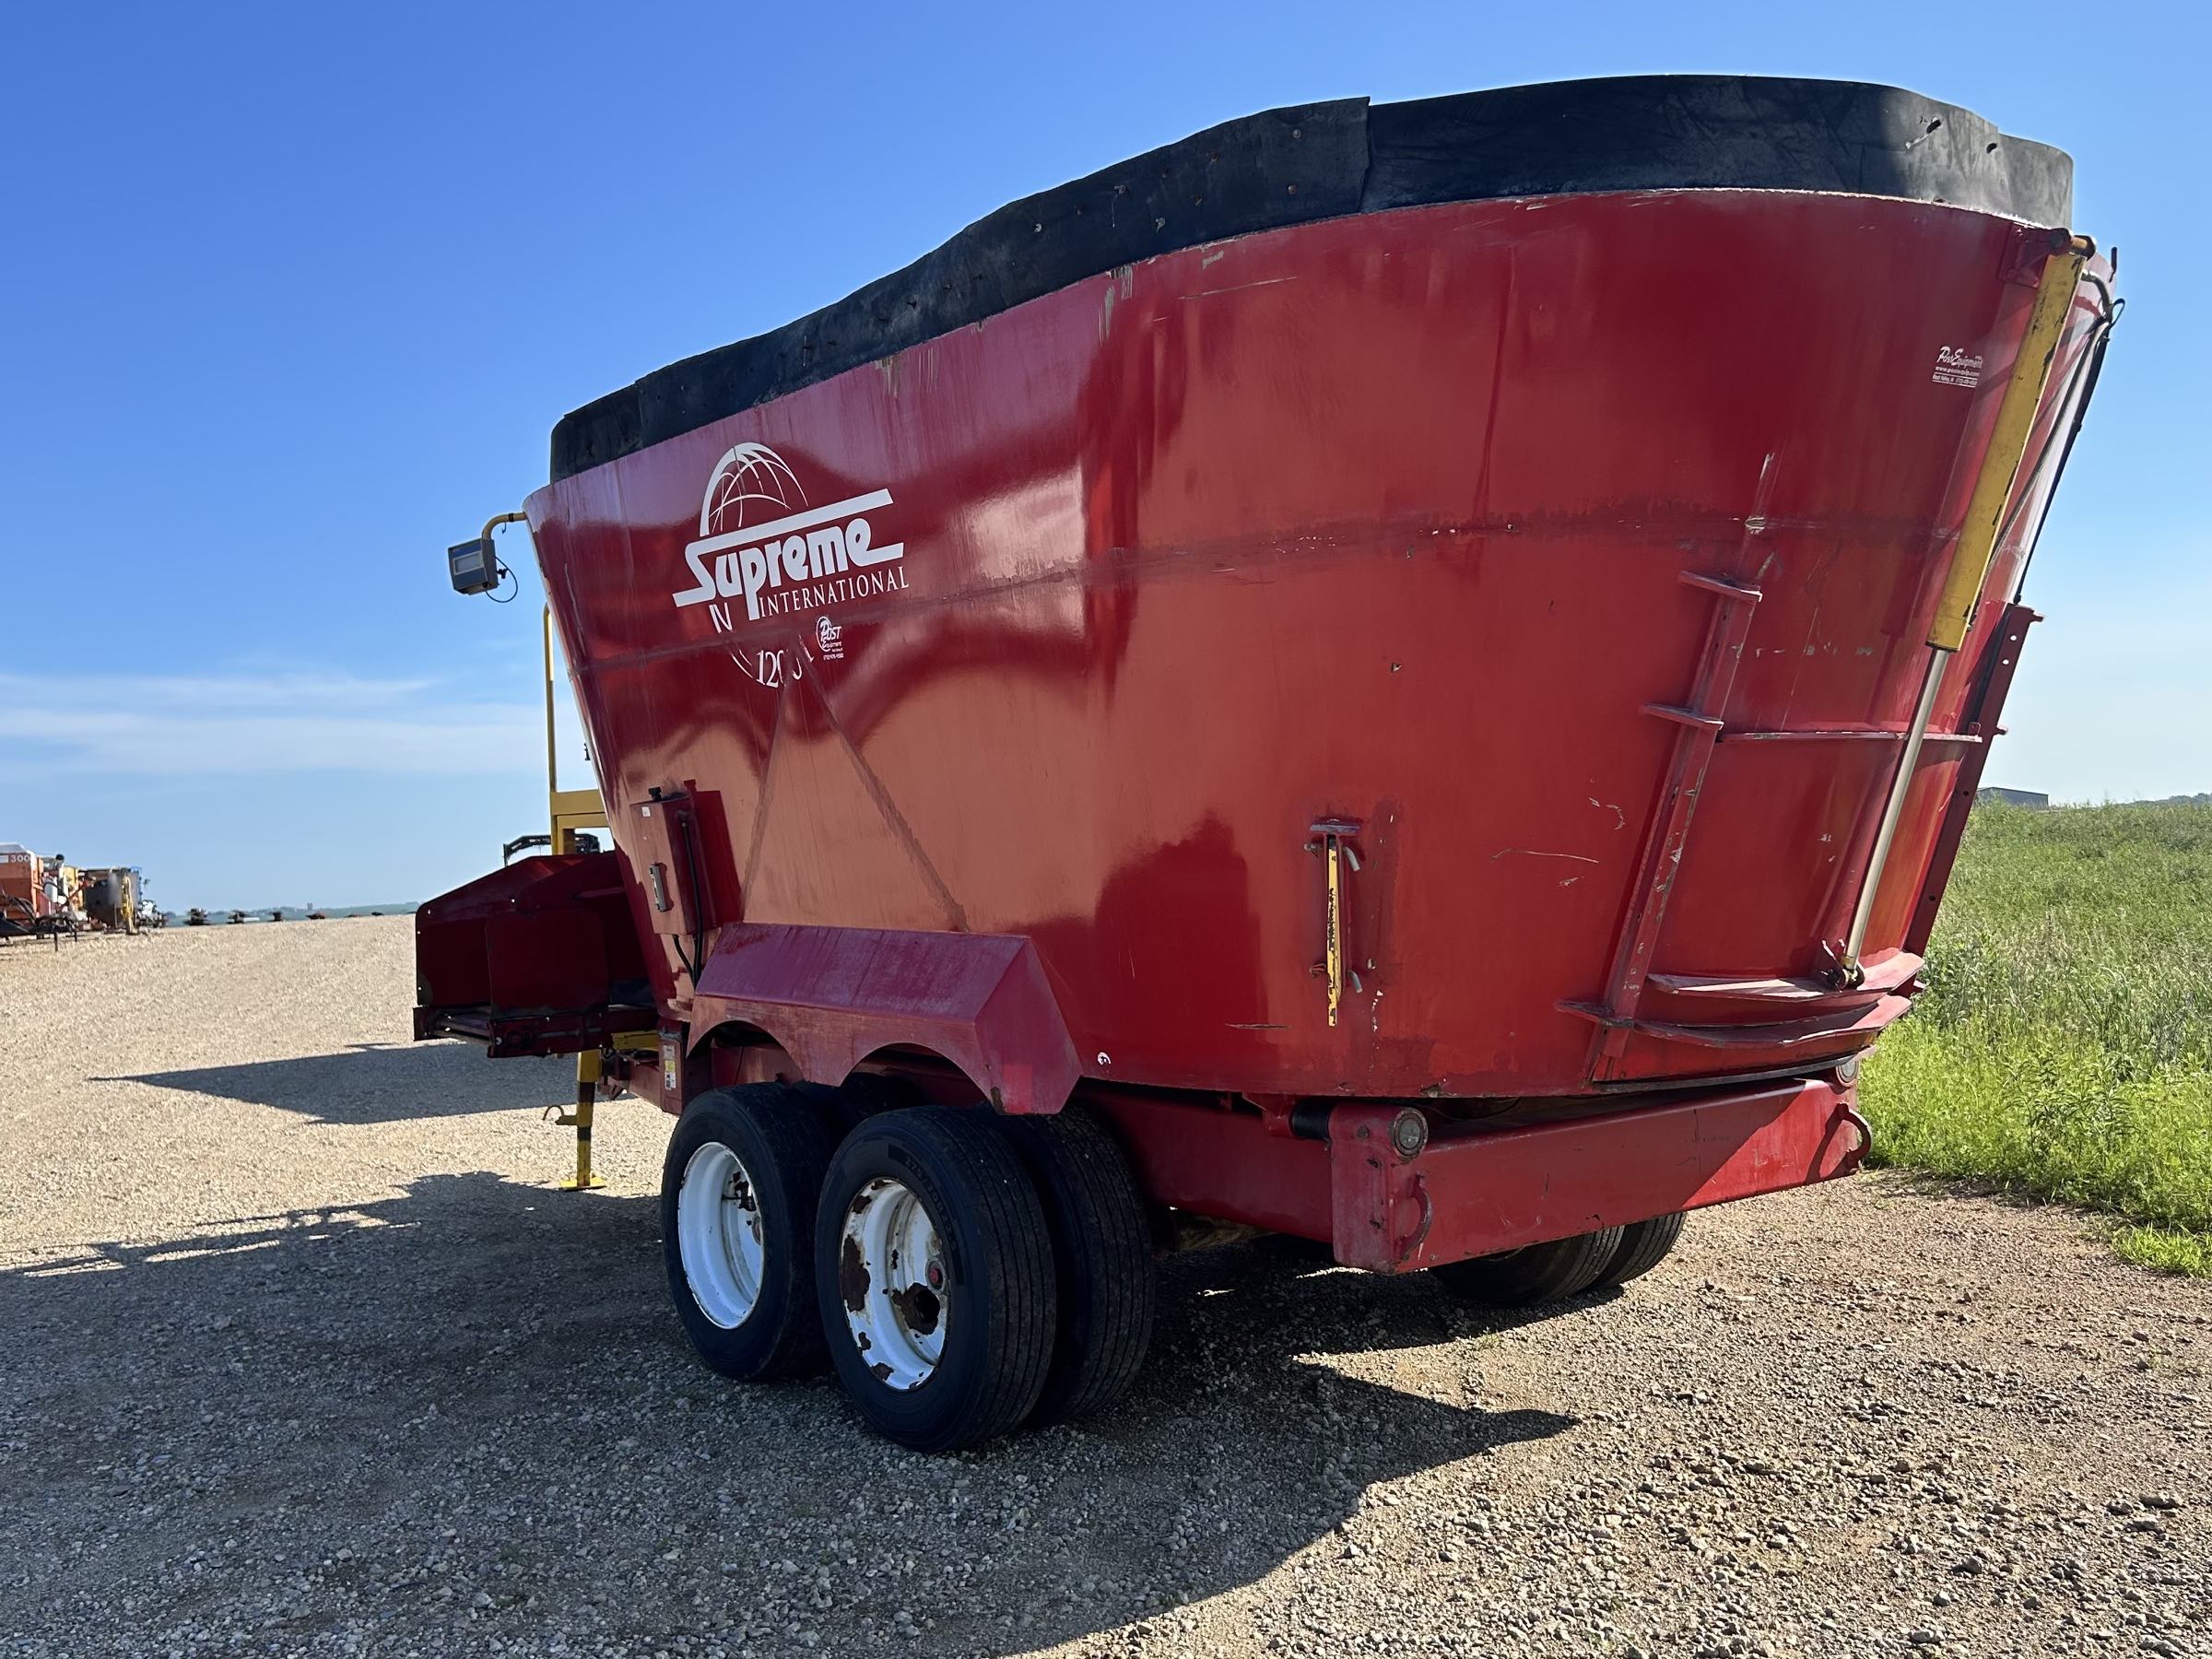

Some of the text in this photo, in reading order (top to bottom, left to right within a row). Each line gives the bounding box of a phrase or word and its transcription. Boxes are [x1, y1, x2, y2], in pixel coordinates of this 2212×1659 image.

[672, 488, 904, 621] Supreme
[759, 566, 909, 618] INTERNATIONAL
[9, 854, 30, 863] 300
